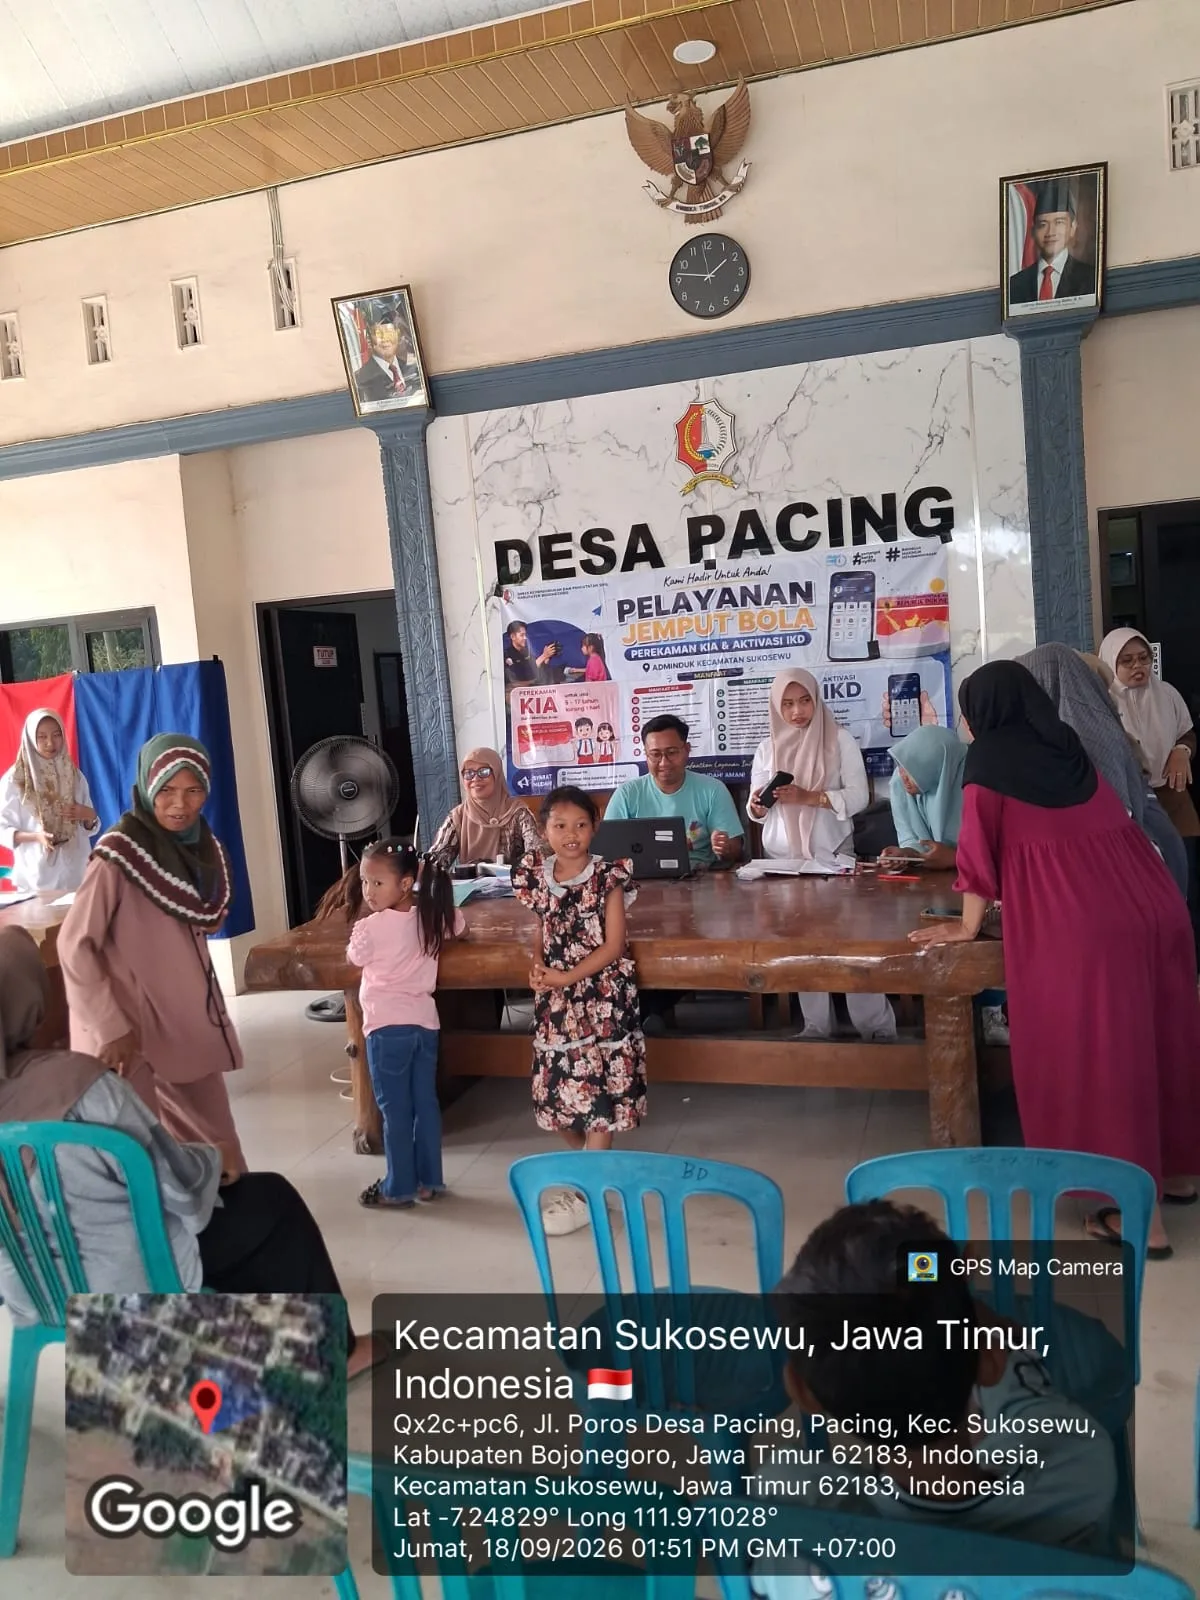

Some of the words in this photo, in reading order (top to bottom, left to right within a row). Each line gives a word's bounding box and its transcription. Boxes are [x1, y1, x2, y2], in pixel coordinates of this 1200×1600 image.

[703, 240, 712, 250] 12
[690, 247, 697, 256] 11
[732, 252, 739, 261] 2
[680, 260, 688, 270] 10
[738, 267, 744, 276] 3
[675, 276, 682, 285] 9
[733, 284, 740, 292] 4
[681, 292, 687, 301] 8
[723, 296, 730, 306] 5
[695, 301, 700, 310] 7
[708, 302, 715, 312] 6
[494, 523, 665, 586] DESA
[686, 486, 954, 566] PACING
[664, 575, 684, 587] Kami
[687, 571, 711, 584] Hadir
[715, 568, 740, 581] Untuk
[743, 565, 771, 577] Anda!
[617, 580, 814, 623] PELAYANAN
[622, 611, 732, 646] JEMPUT
[738, 607, 815, 633] BOLA
[630, 643, 697, 659] PEREKAMAN
[700, 641, 718, 652] KIA
[721, 640, 729, 650] &
[732, 636, 783, 649] AKTIVASI
[786, 633, 805, 645] IKD
[652, 660, 695, 671] ADMINDUK
[697, 656, 745, 668] KECAMATAN
[746, 652, 791, 664] SUKOSEWU
[694, 670, 727, 679] MANFAAT
[823, 674, 856, 682] AKTIVASI
[823, 681, 862, 700] IKD
[520, 696, 558, 715] KIA
[685, 761, 713, 769] nfaatkan
